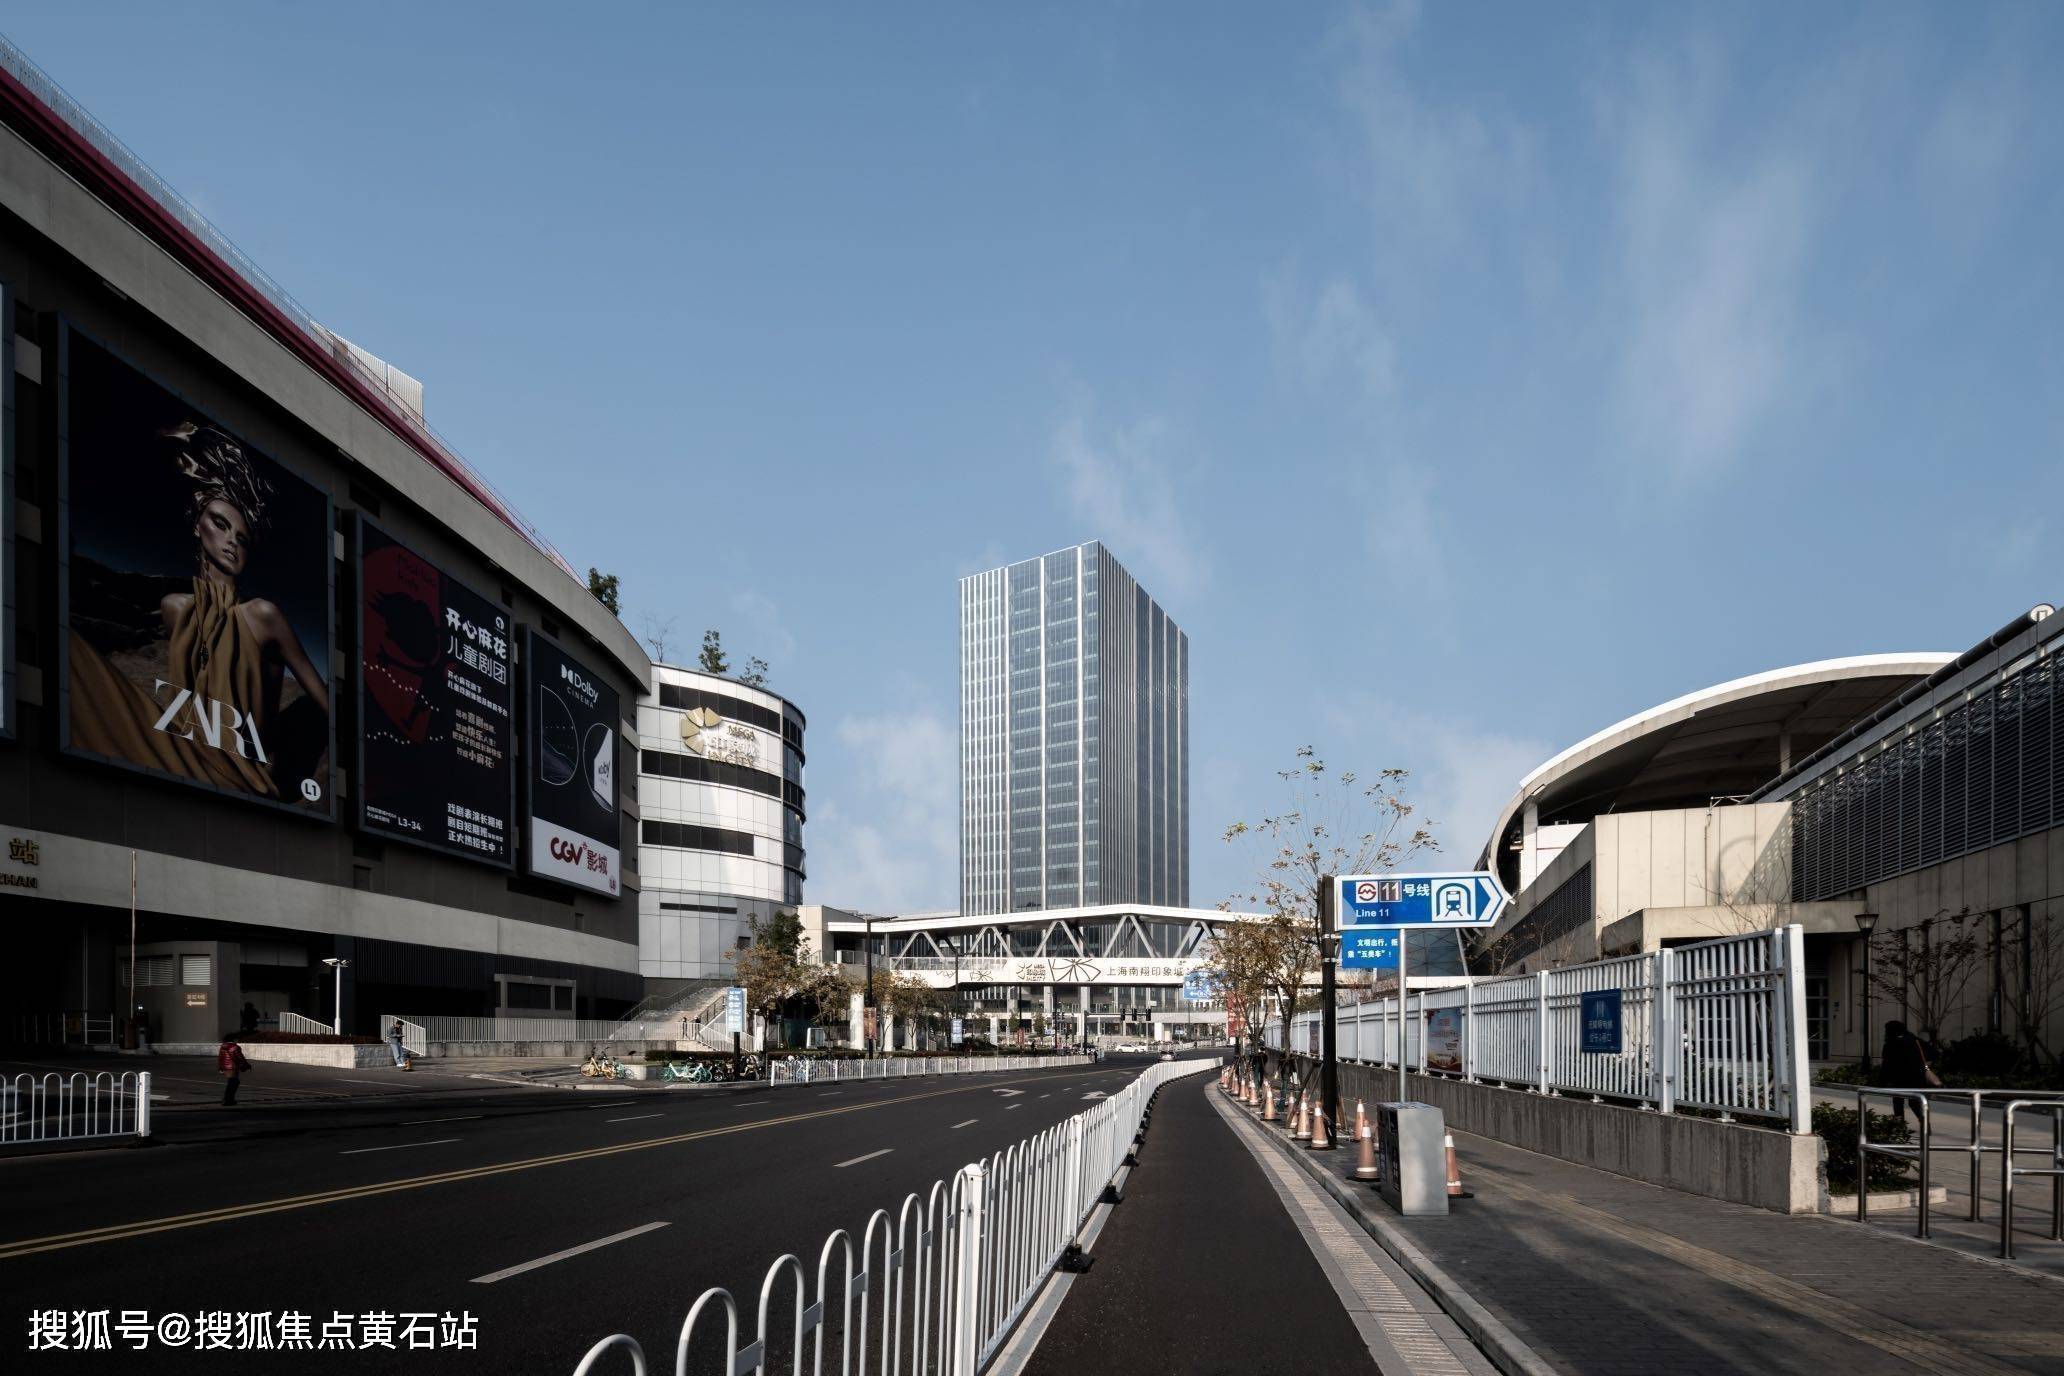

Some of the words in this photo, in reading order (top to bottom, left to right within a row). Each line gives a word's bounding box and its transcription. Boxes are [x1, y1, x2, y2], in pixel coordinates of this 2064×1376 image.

[446, 607, 507, 659] 开心麻花
[447, 635, 507, 685] 儿童剧团
[566, 686, 594, 710] CINEMA
[573, 672, 599, 702] Dolby
[153, 678, 272, 765] ZARA
[304, 782, 317, 797] L1
[398, 816, 422, 832] L3-34
[9, 838, 39, 865] 站
[550, 837, 582, 866] CGV
[587, 849, 608, 876] 影城
[1356, 909, 1377, 917] Line
[1379, 908, 1390, 917] 11
[1106, 966, 1183, 976] 上海南翔印象城
